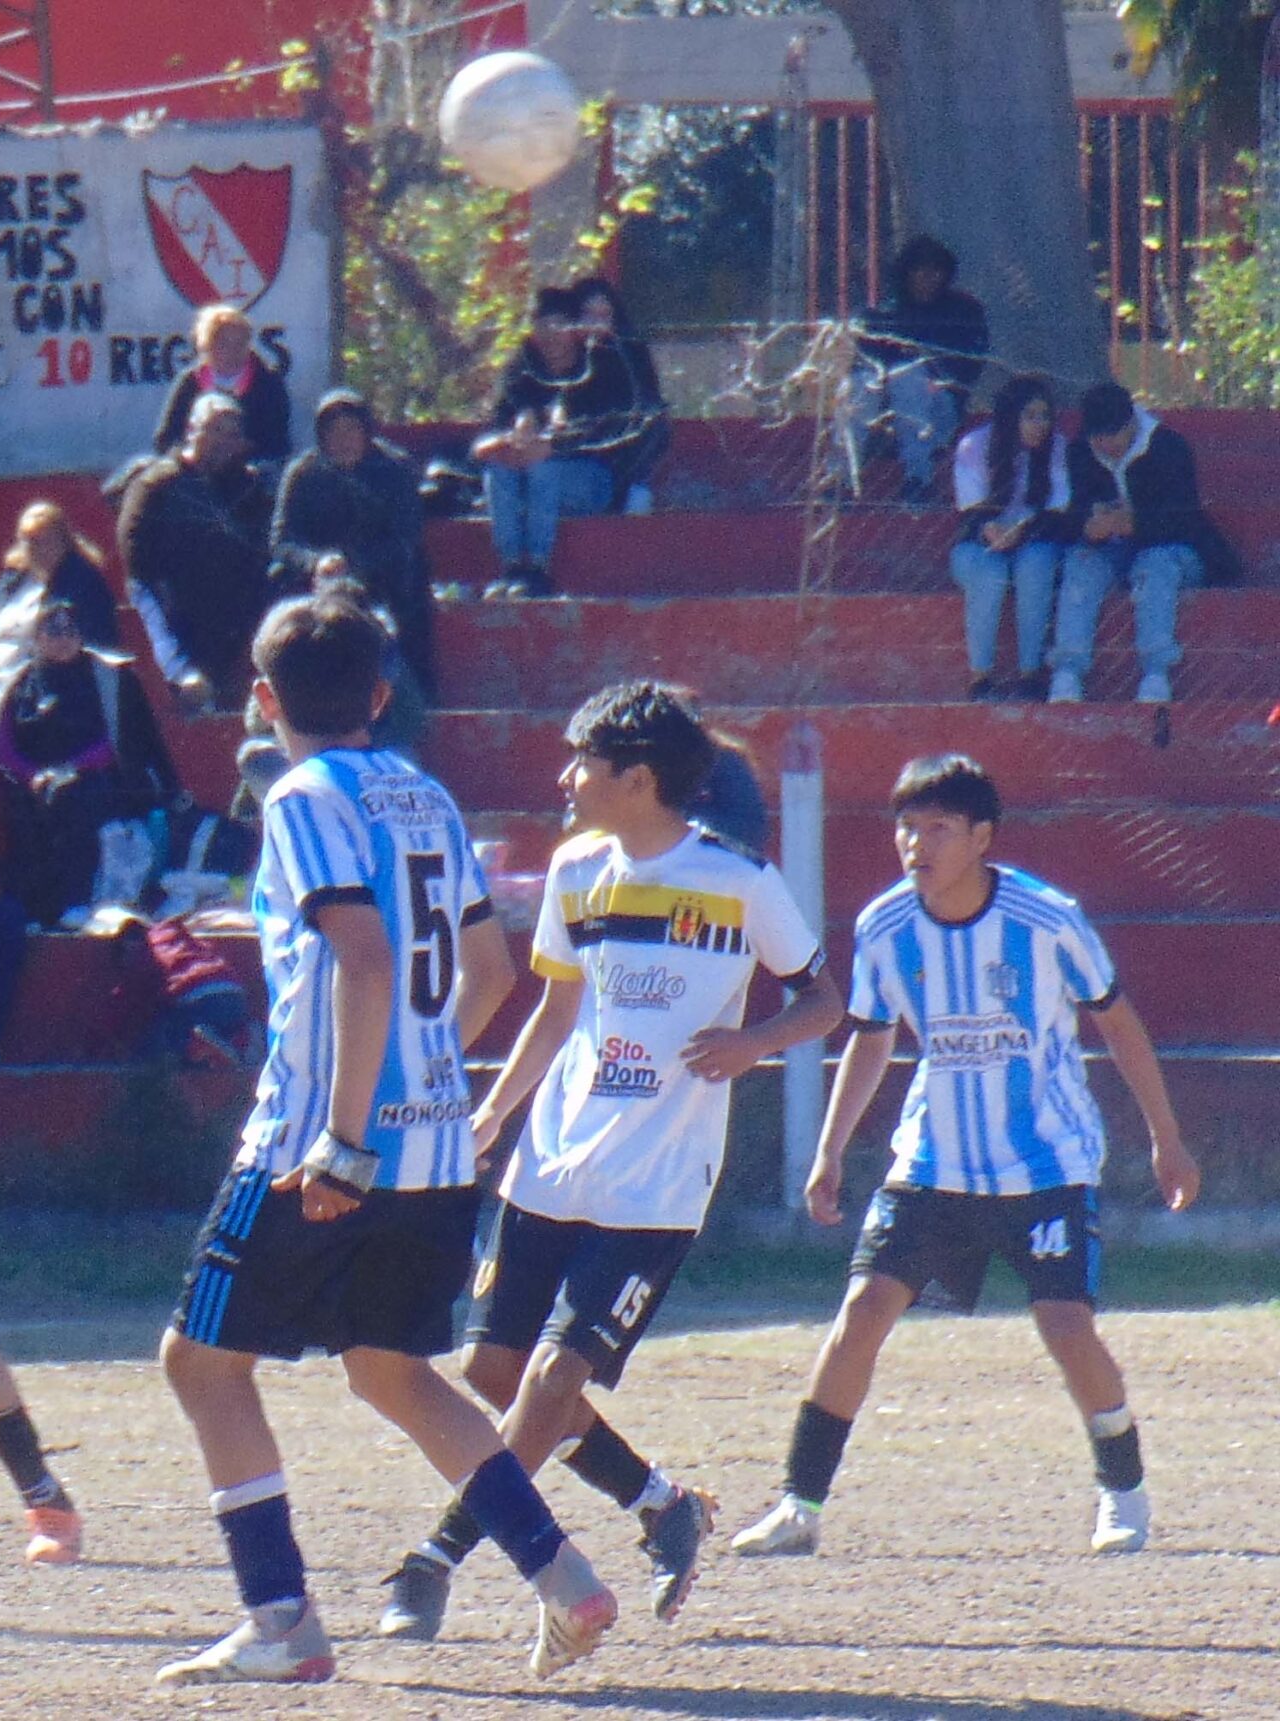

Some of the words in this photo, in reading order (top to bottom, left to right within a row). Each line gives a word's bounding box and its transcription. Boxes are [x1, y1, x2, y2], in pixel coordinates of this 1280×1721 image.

[13, 282, 105, 335] CON
[37, 337, 94, 388] 10
[109, 326, 293, 385] REGS
[406, 853, 455, 1018] 5
[611, 1274, 652, 1330] 15
